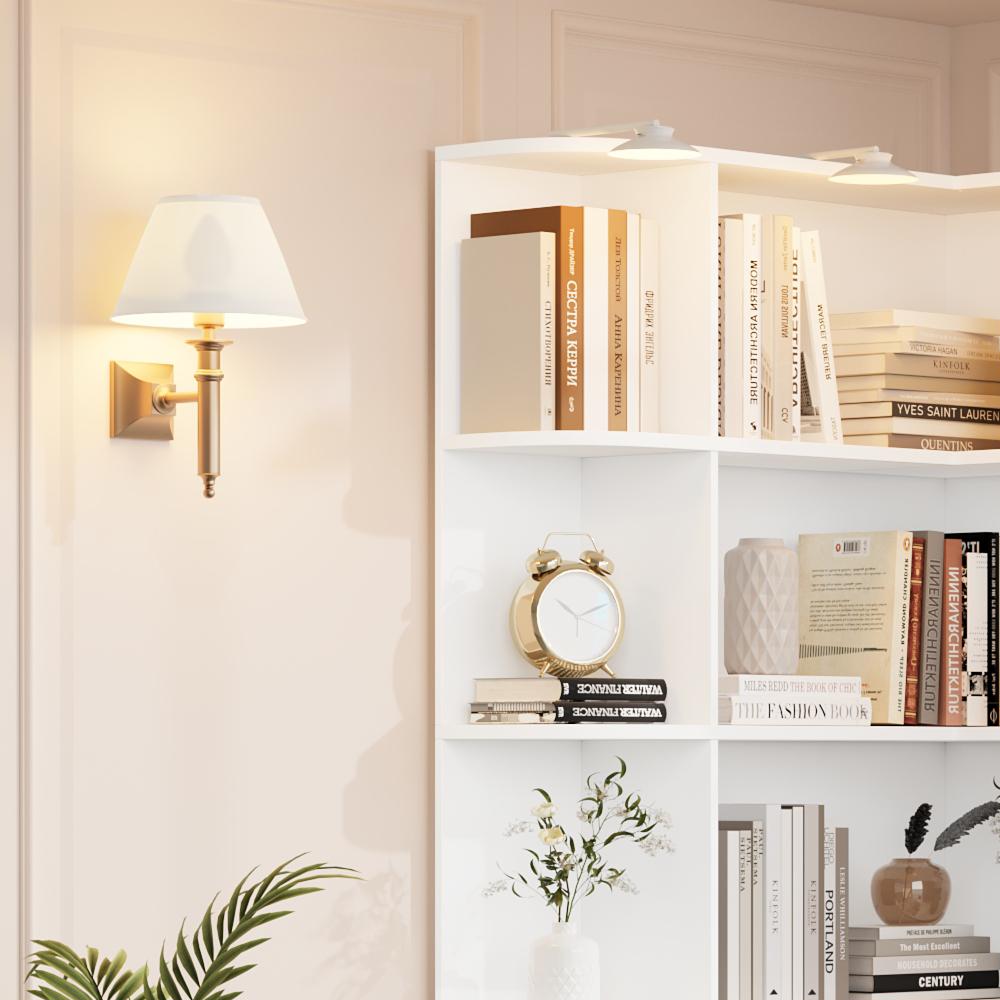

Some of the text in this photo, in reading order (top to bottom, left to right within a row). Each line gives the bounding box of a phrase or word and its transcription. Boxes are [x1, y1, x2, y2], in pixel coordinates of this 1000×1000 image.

[566, 280, 578, 387] СЕСТРА КЕРРИ
[644, 290, 655, 365] ФРИДРИХ ЭНГЕЛЬС
[909, 342, 936, 354] VICTORIA
[937, 346, 958, 355] HAGAN
[934, 360, 970, 370] KINFOLK
[897, 404, 924, 416] YVES
[927, 406, 957, 418] SAINT
[920, 438, 973, 450] QUENTINS
[577, 683, 622, 694] FINANCE
[622, 685, 663, 695] WALTER
[744, 680, 767, 692] MILES
[769, 681, 789, 692] REDD
[790, 682, 804, 693] THE
[806, 682, 827, 693] BOOK
[828, 682, 839, 693] OF
[840, 682, 857, 693] CHIC
[572, 707, 620, 717] FINANCE
[620, 708, 662, 718] WALTER
[734, 702, 868, 720] THE FASHION BOOK
[825, 889, 834, 974] PORTLAND
[913, 943, 929, 951] Most
[930, 942, 960, 950] Excellent
[897, 958, 978, 970] HOUSEHOLD DECORATES
[918, 975, 964, 988] CENTURY
